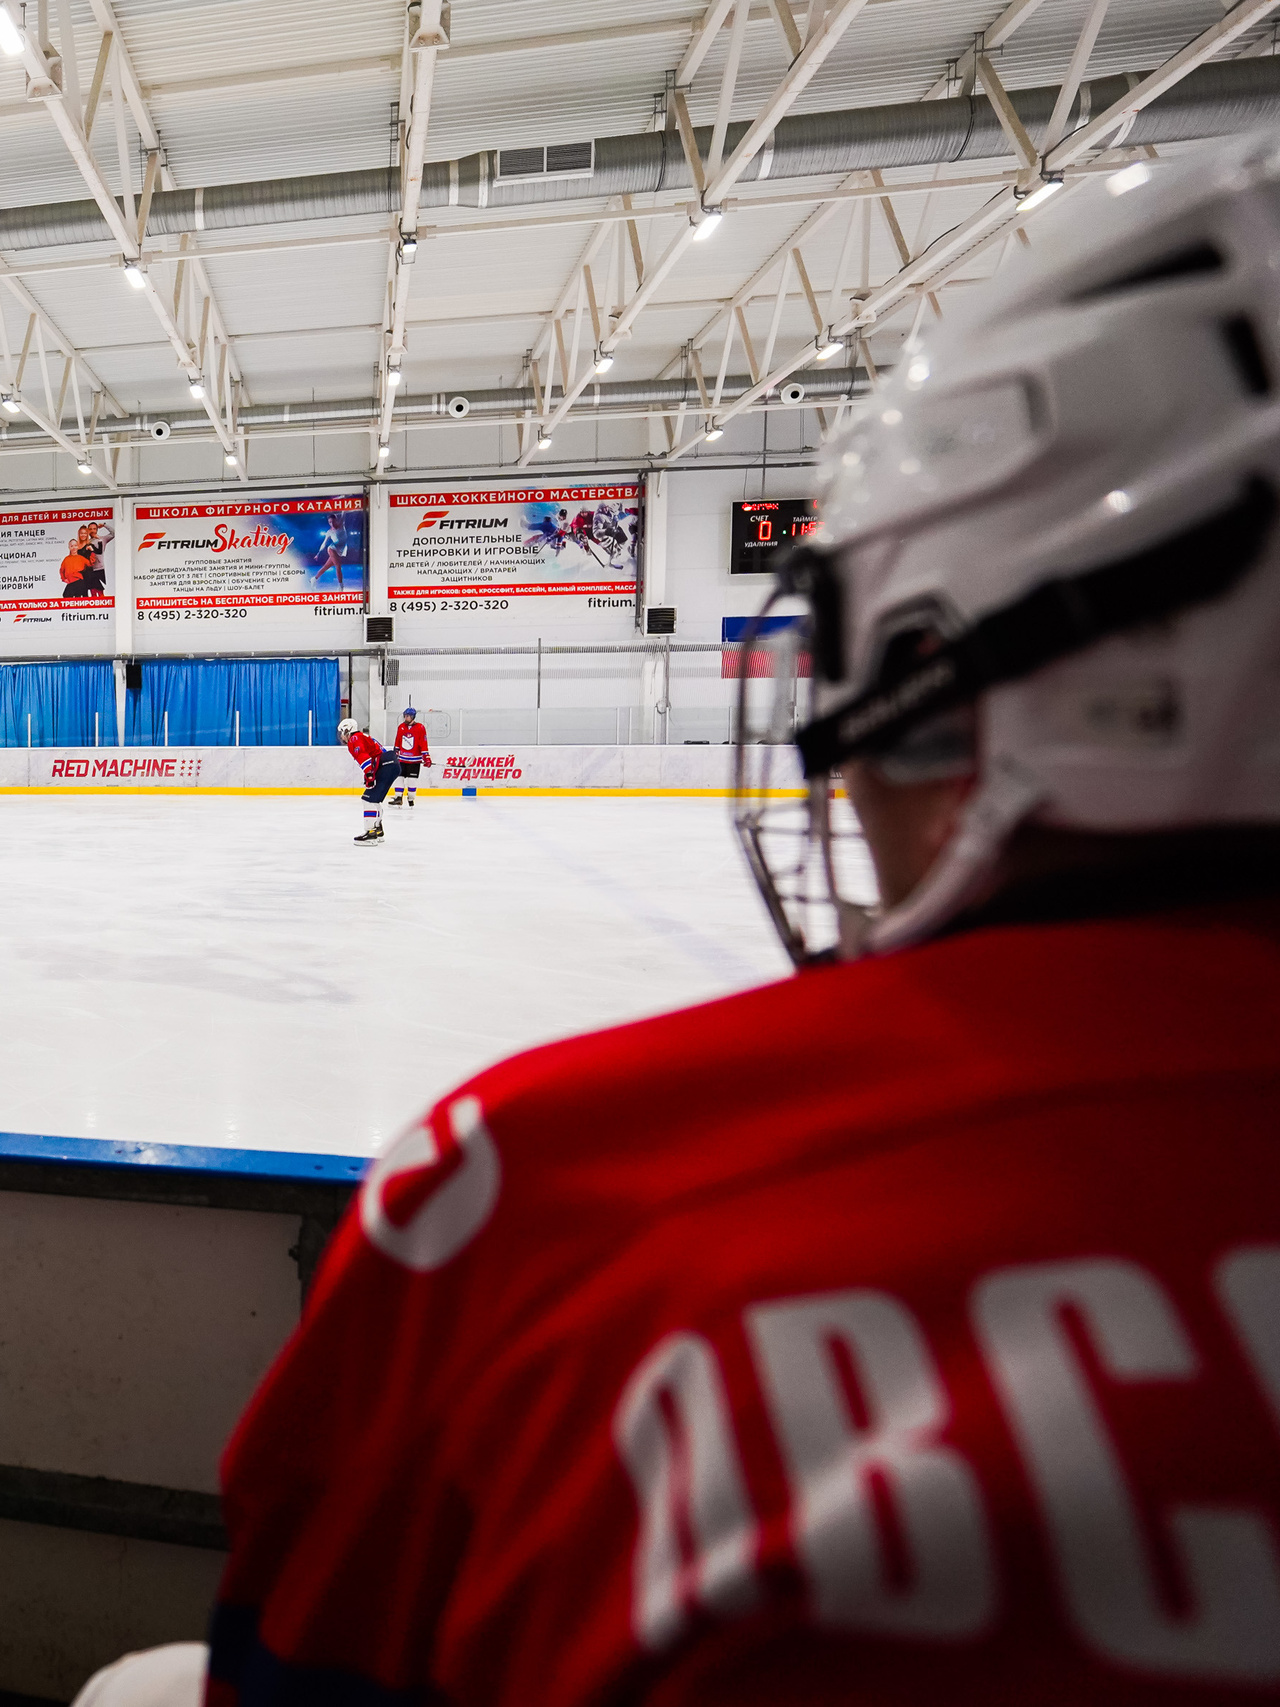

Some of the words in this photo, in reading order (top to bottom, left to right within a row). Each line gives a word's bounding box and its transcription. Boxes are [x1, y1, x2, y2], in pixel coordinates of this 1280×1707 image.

[396, 494, 446, 505] ШКОЛА
[452, 490, 544, 503] ХОККЕЙНОГО
[149, 507, 198, 517] ШКОЛА
[205, 503, 290, 515] ФИГУРНОГО
[297, 500, 362, 511] КАТАНИЯ
[1, 515, 19, 523] ДЛЯ
[22, 512, 50, 522] ДЕТЕЙ
[61, 510, 109, 519] ВЗРОСЛЫХ
[439, 518, 508, 529] FITRIUM
[759, 520, 772, 540] 0
[14, 529, 45, 538] ТАНЦЕВ
[158, 539, 218, 549] FITRIUM
[211, 523, 294, 554] Skating
[412, 534, 522, 547] ДОПОЛНИТЕЛЬНЫЕ
[396, 548, 470, 557] ТРЕНИРОВКИ
[474, 548, 480, 556] И
[485, 546, 539, 556] ИГРОВЫЕ
[436, 559, 482, 567] ЛЮБИТЕЛЕЙ
[18, 601, 47, 609] ТОЛЬКО
[139, 599, 199, 607] ЗАПИШИТЕСЬ
[215, 596, 274, 605] БЕСПЛАТНОЕ
[276, 594, 320, 603] ПРОБНОЕ
[322, 593, 364, 602] ЗАНЯТИЕ
[389, 602, 397, 611] 8
[401, 601, 436, 613] (495)
[440, 600, 509, 610] 2-320-320
[588, 597, 636, 608] fitrium.
[61, 612, 109, 621] fitrium.ru
[137, 611, 145, 620] 8
[148, 610, 181, 621] (495)
[184, 608, 248, 619] 2-320-320
[314, 605, 369, 616] fitrium.r
[446, 754, 516, 768] #ХОККЕЙ
[52, 759, 89, 778] RED
[92, 758, 177, 778] MACHINE
[442, 768, 523, 781] БУДУЩЕГО
